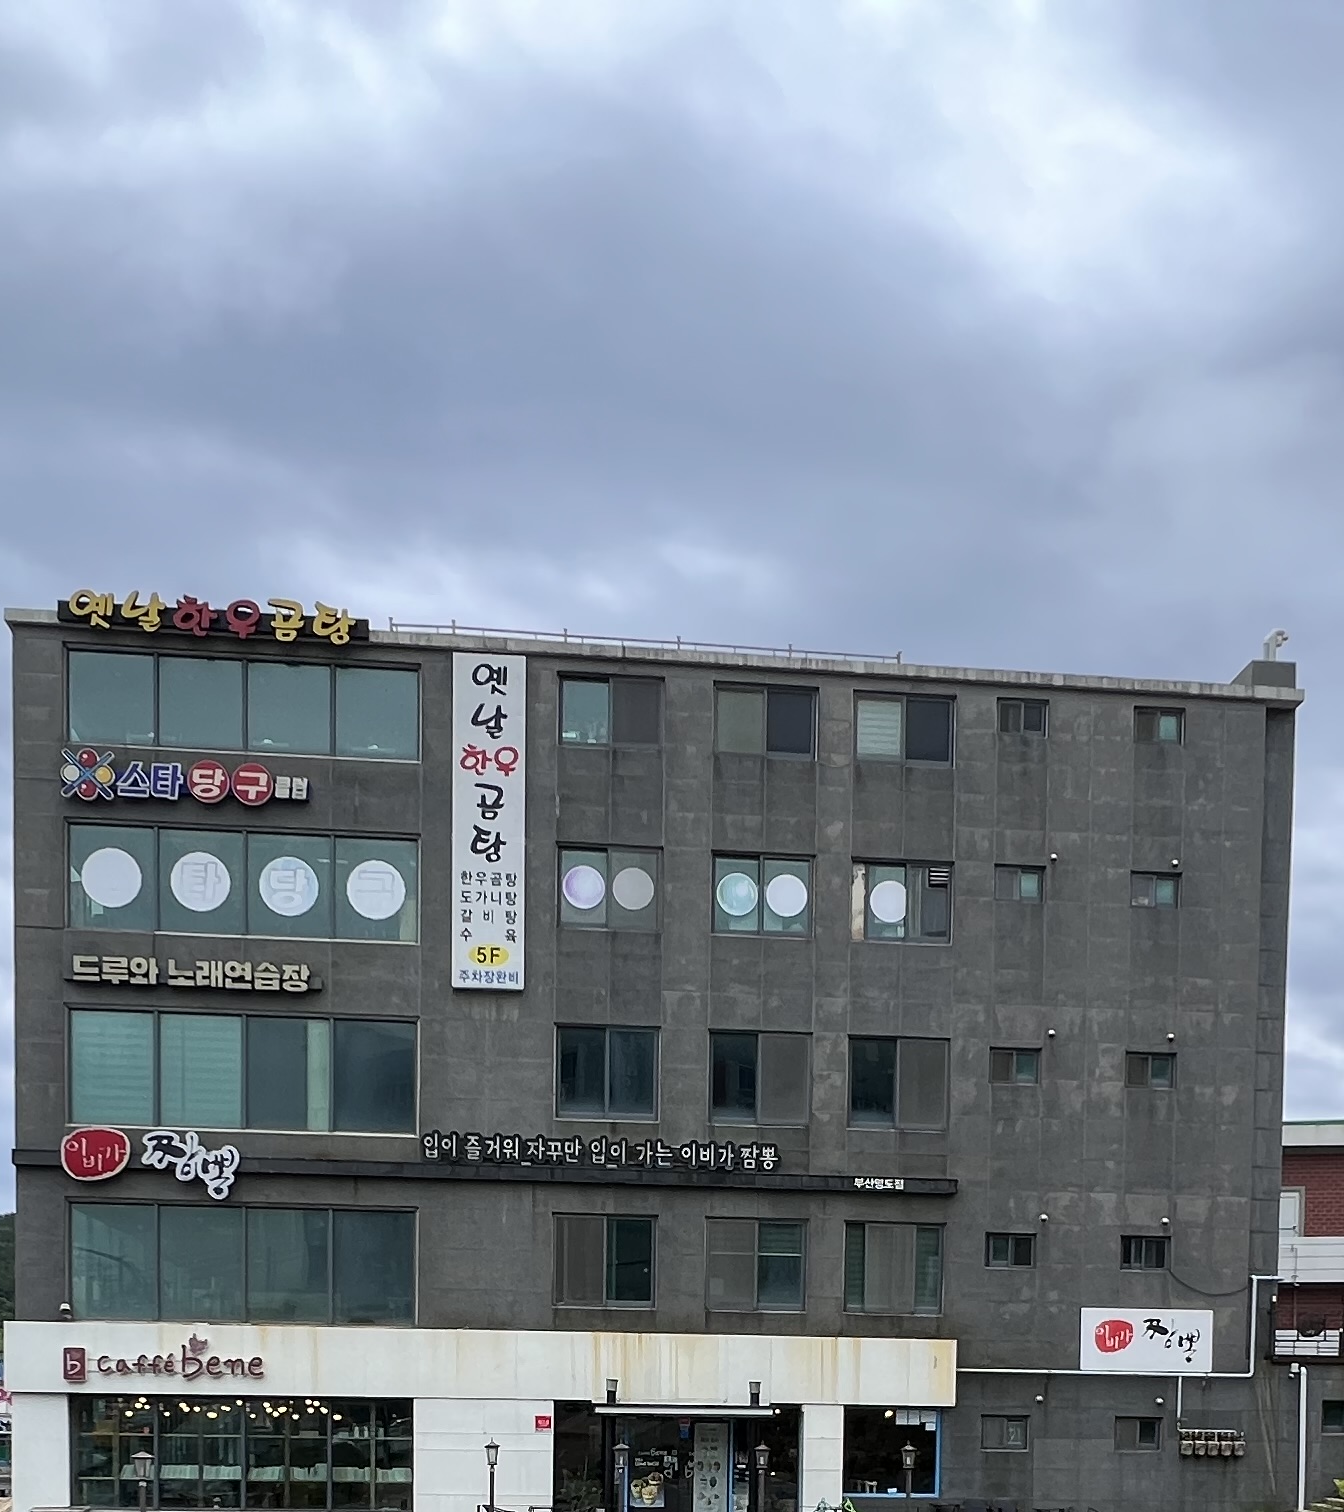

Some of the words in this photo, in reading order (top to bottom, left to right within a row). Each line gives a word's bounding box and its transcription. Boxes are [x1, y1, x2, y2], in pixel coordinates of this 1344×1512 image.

[460, 870, 517, 888] 한우곰탕
[460, 890, 517, 906] 도가니탕
[476, 946, 501, 964] 5F
[72, 955, 158, 985] 드루와
[167, 958, 310, 992] 노래연습장
[459, 970, 519, 985] 주차장완비
[423, 1132, 457, 1159] 입이
[464, 1135, 519, 1160] 즐거워
[526, 1137, 582, 1163] 자꾸만
[590, 1137, 626, 1165] 입이
[635, 1140, 674, 1166] 가는
[681, 1143, 735, 1167] 이비가
[740, 1144, 779, 1170] 짬뽕
[65, 1137, 127, 1172] 이비가
[143, 1133, 238, 1197] 짬뽕
[1095, 1324, 1134, 1349] 이비가
[1141, 1318, 1201, 1364] 짬뽕
